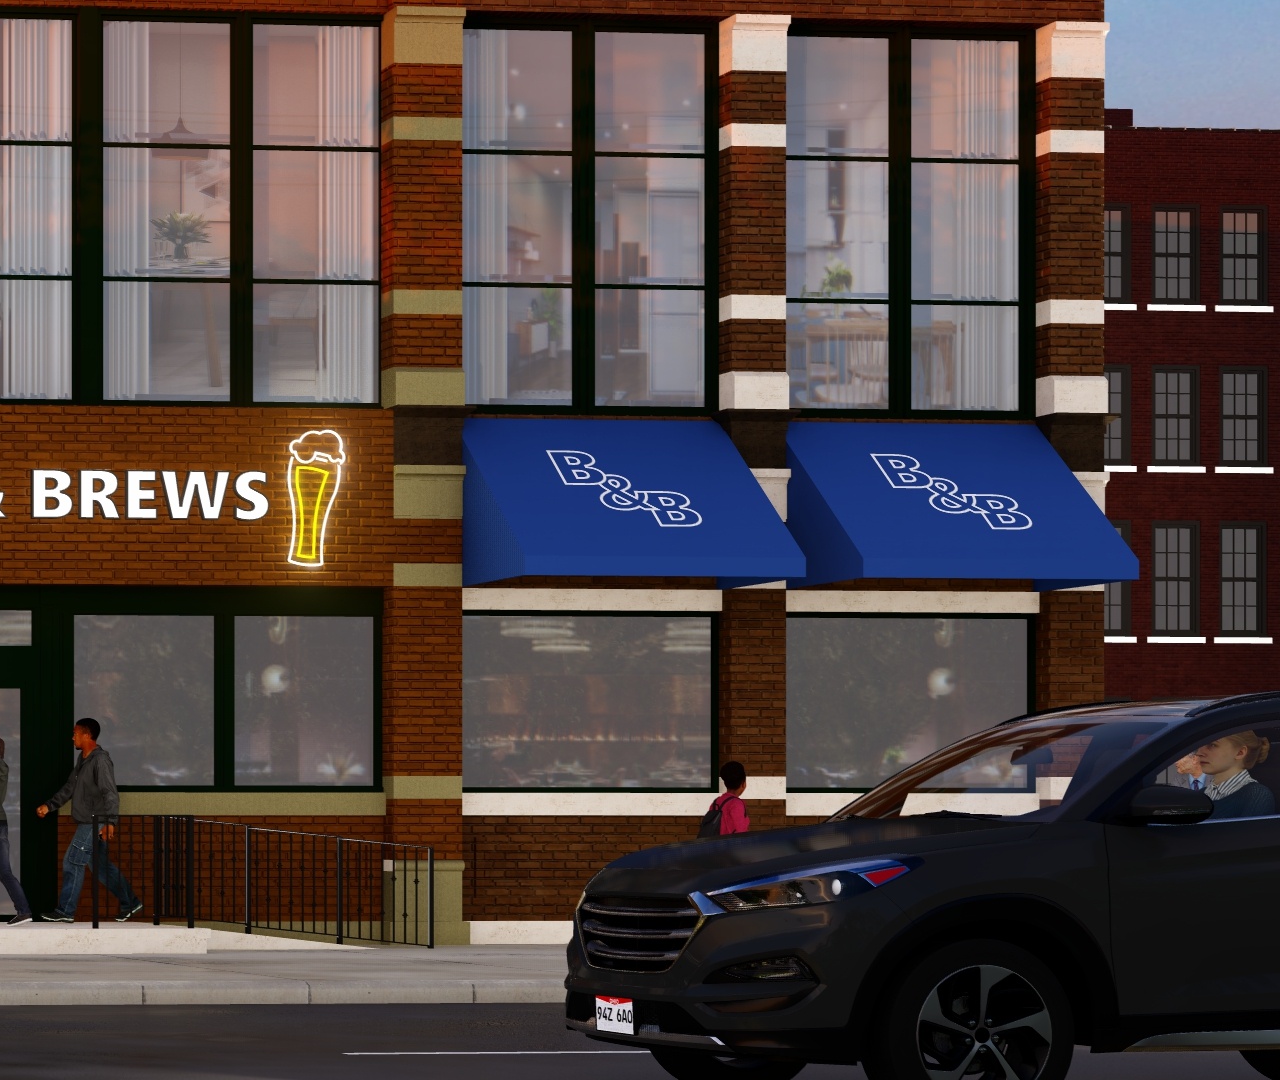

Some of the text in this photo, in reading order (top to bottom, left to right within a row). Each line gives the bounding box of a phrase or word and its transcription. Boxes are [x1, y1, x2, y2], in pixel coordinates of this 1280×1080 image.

[32, 467, 271, 521] BREWS
[546, 449, 703, 528] B&B
[870, 453, 1033, 531] B&B
